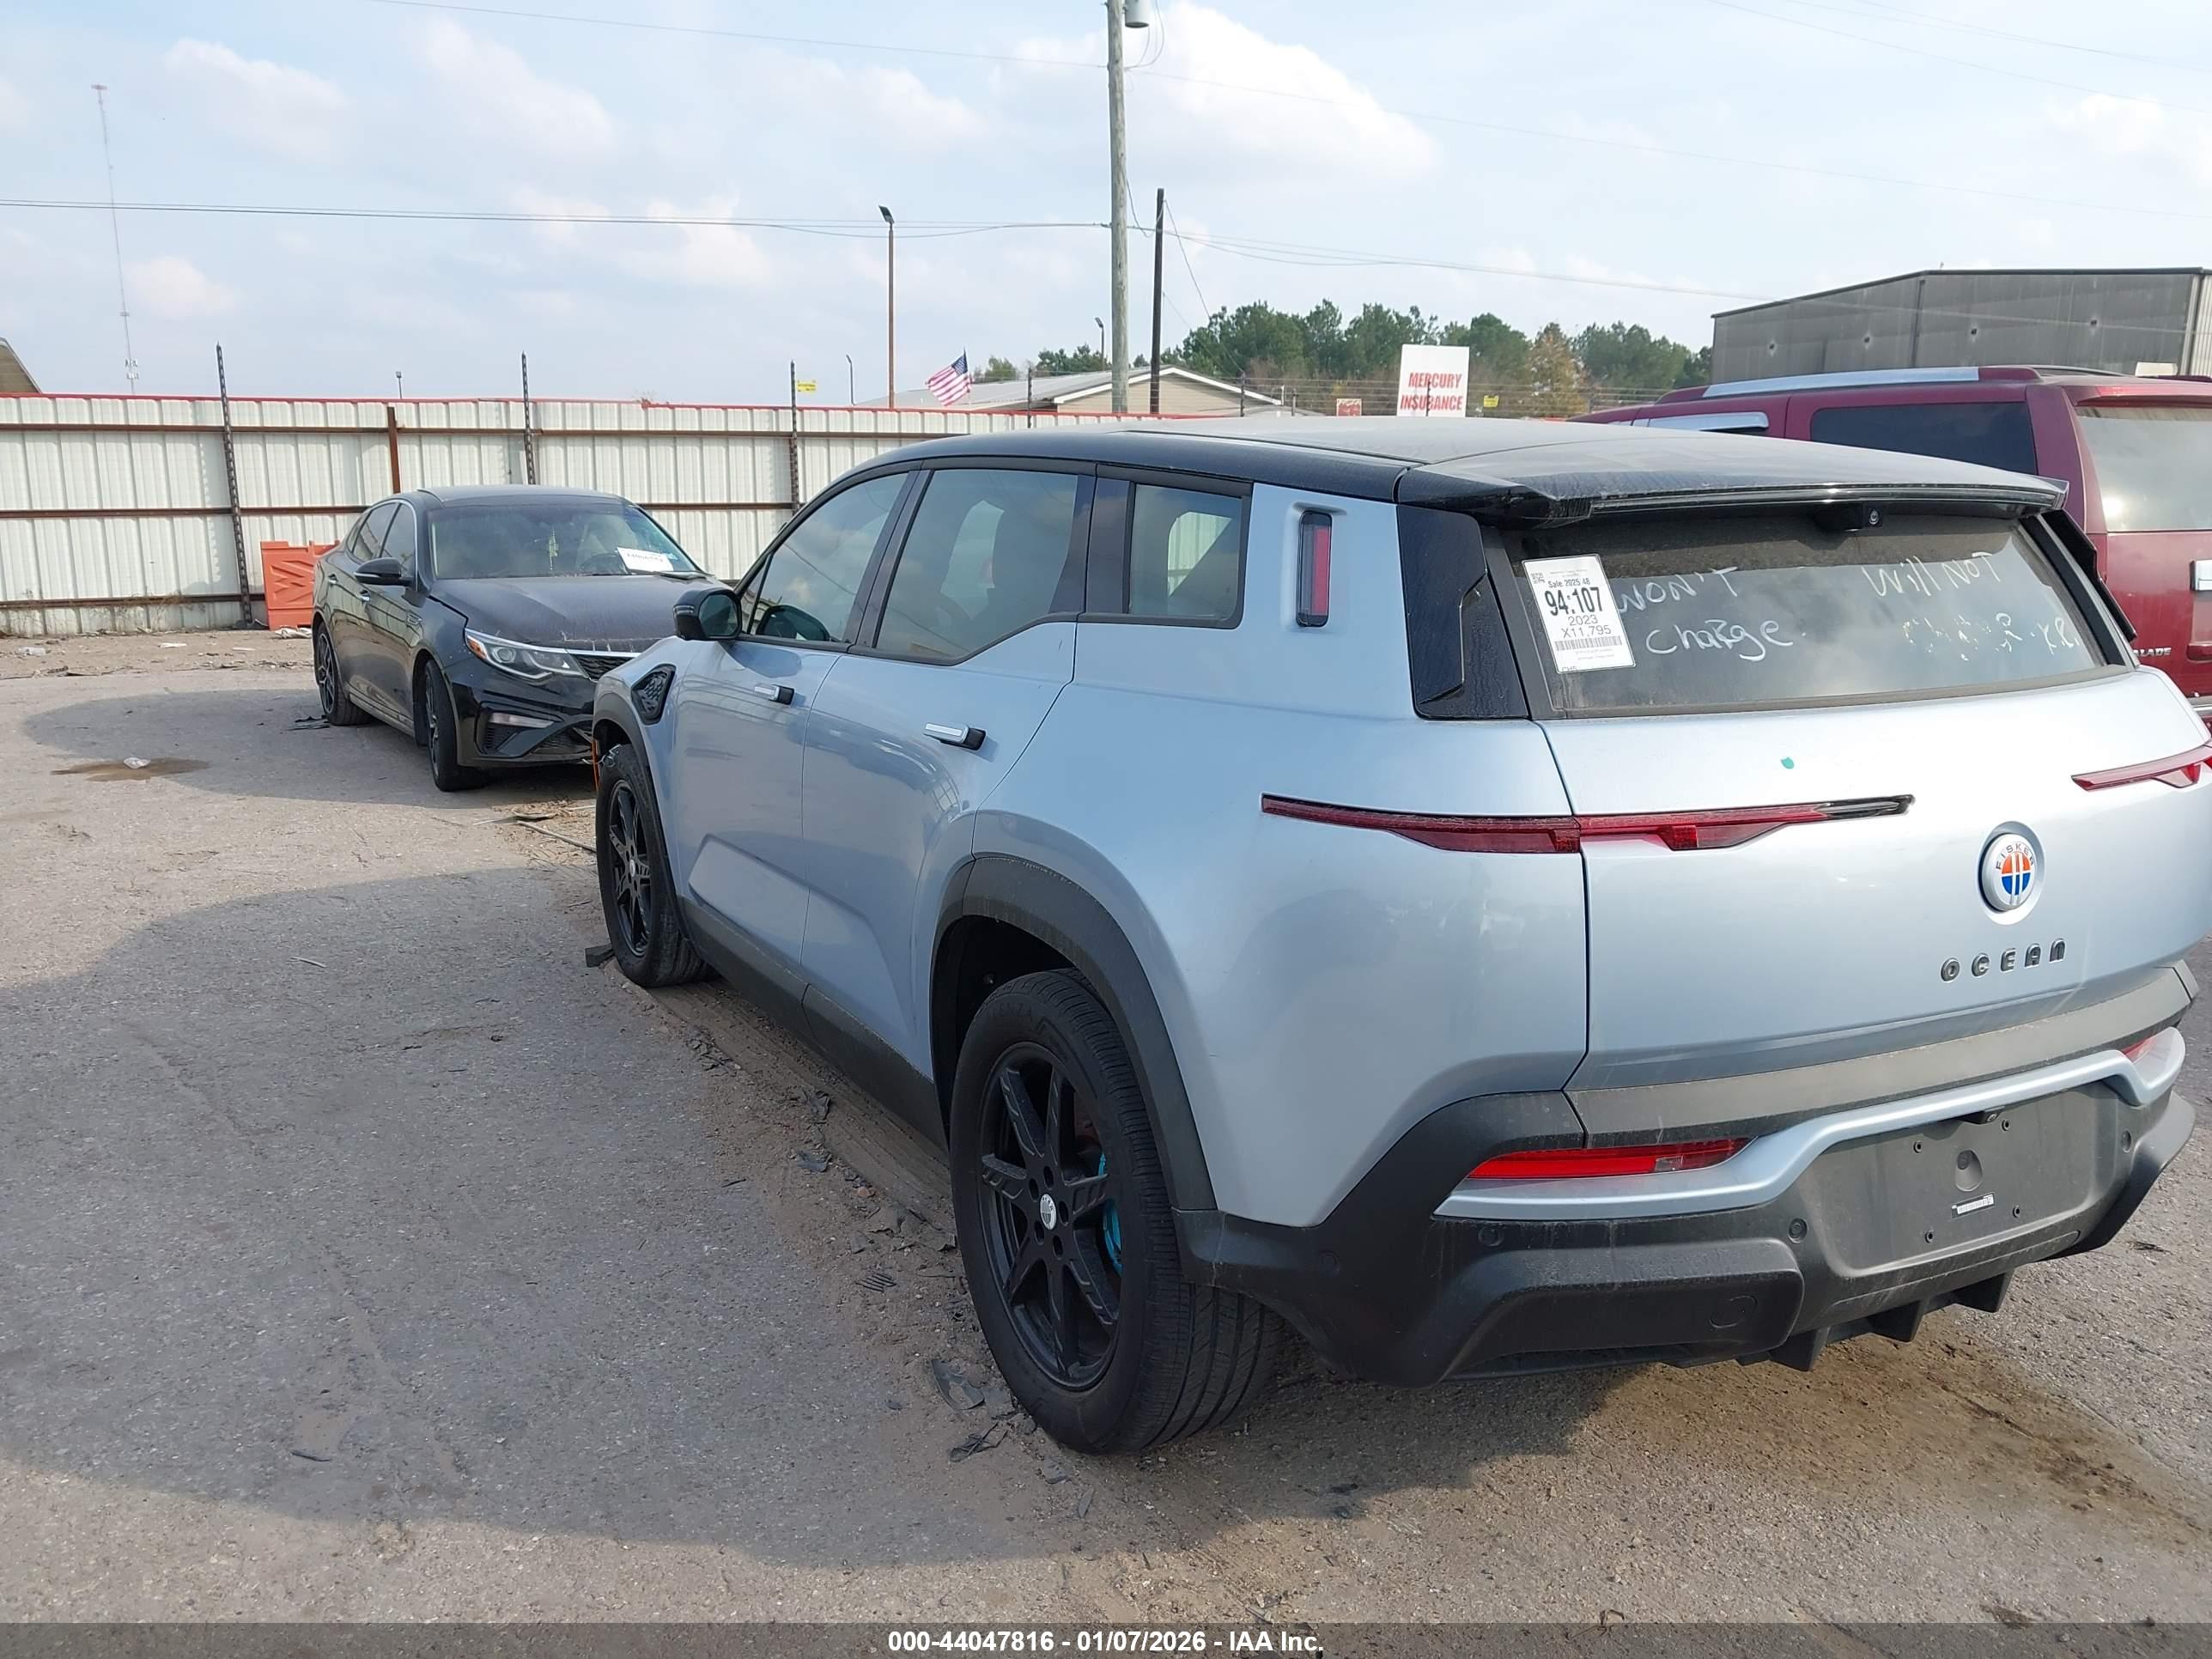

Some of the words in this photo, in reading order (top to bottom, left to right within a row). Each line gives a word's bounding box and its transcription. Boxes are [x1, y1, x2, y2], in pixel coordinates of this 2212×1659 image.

[1408, 373, 1462, 388] MERCURY
[1400, 395, 1463, 410] INSURANCE
[1547, 580, 1563, 589] Sale
[1564, 578, 1581, 587] 2025
[1545, 586, 1603, 617] 94:107
[1568, 614, 1599, 626] 2023
[1995, 842, 2035, 871] FISKER
[1940, 937, 2067, 984] OCEAN
